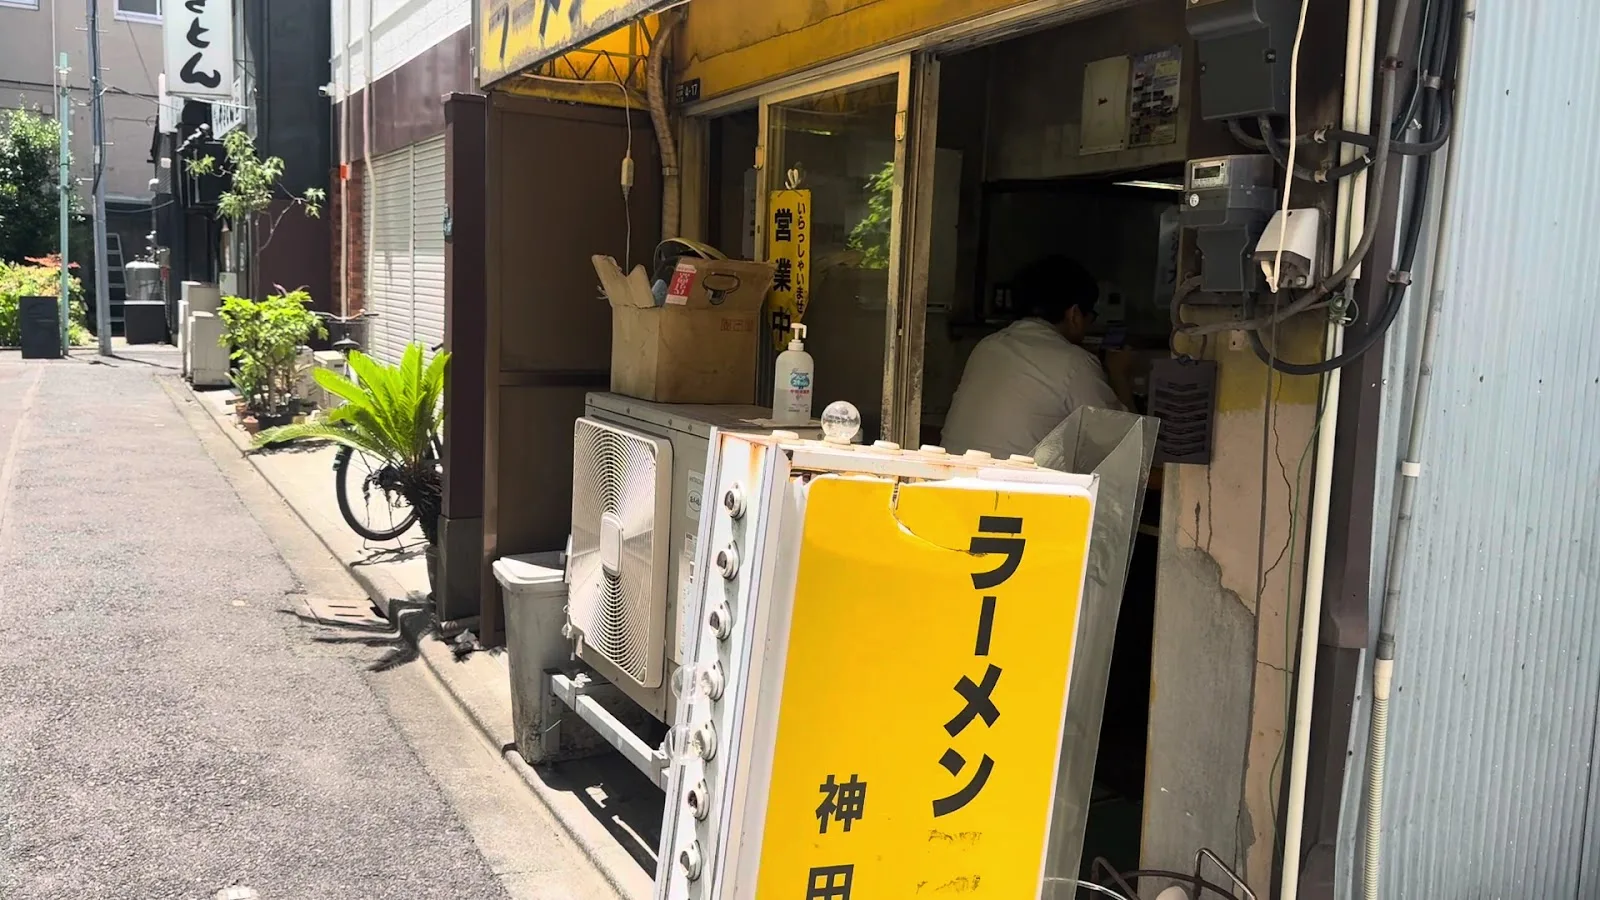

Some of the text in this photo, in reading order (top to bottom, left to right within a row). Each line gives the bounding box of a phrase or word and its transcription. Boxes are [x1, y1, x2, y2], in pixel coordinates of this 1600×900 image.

[772, 207, 793, 342] 営業中
[796, 202, 806, 314] いらっしゃいませ
[932, 515, 1026, 818] ラーメン
[805, 773, 867, 900] 神田
